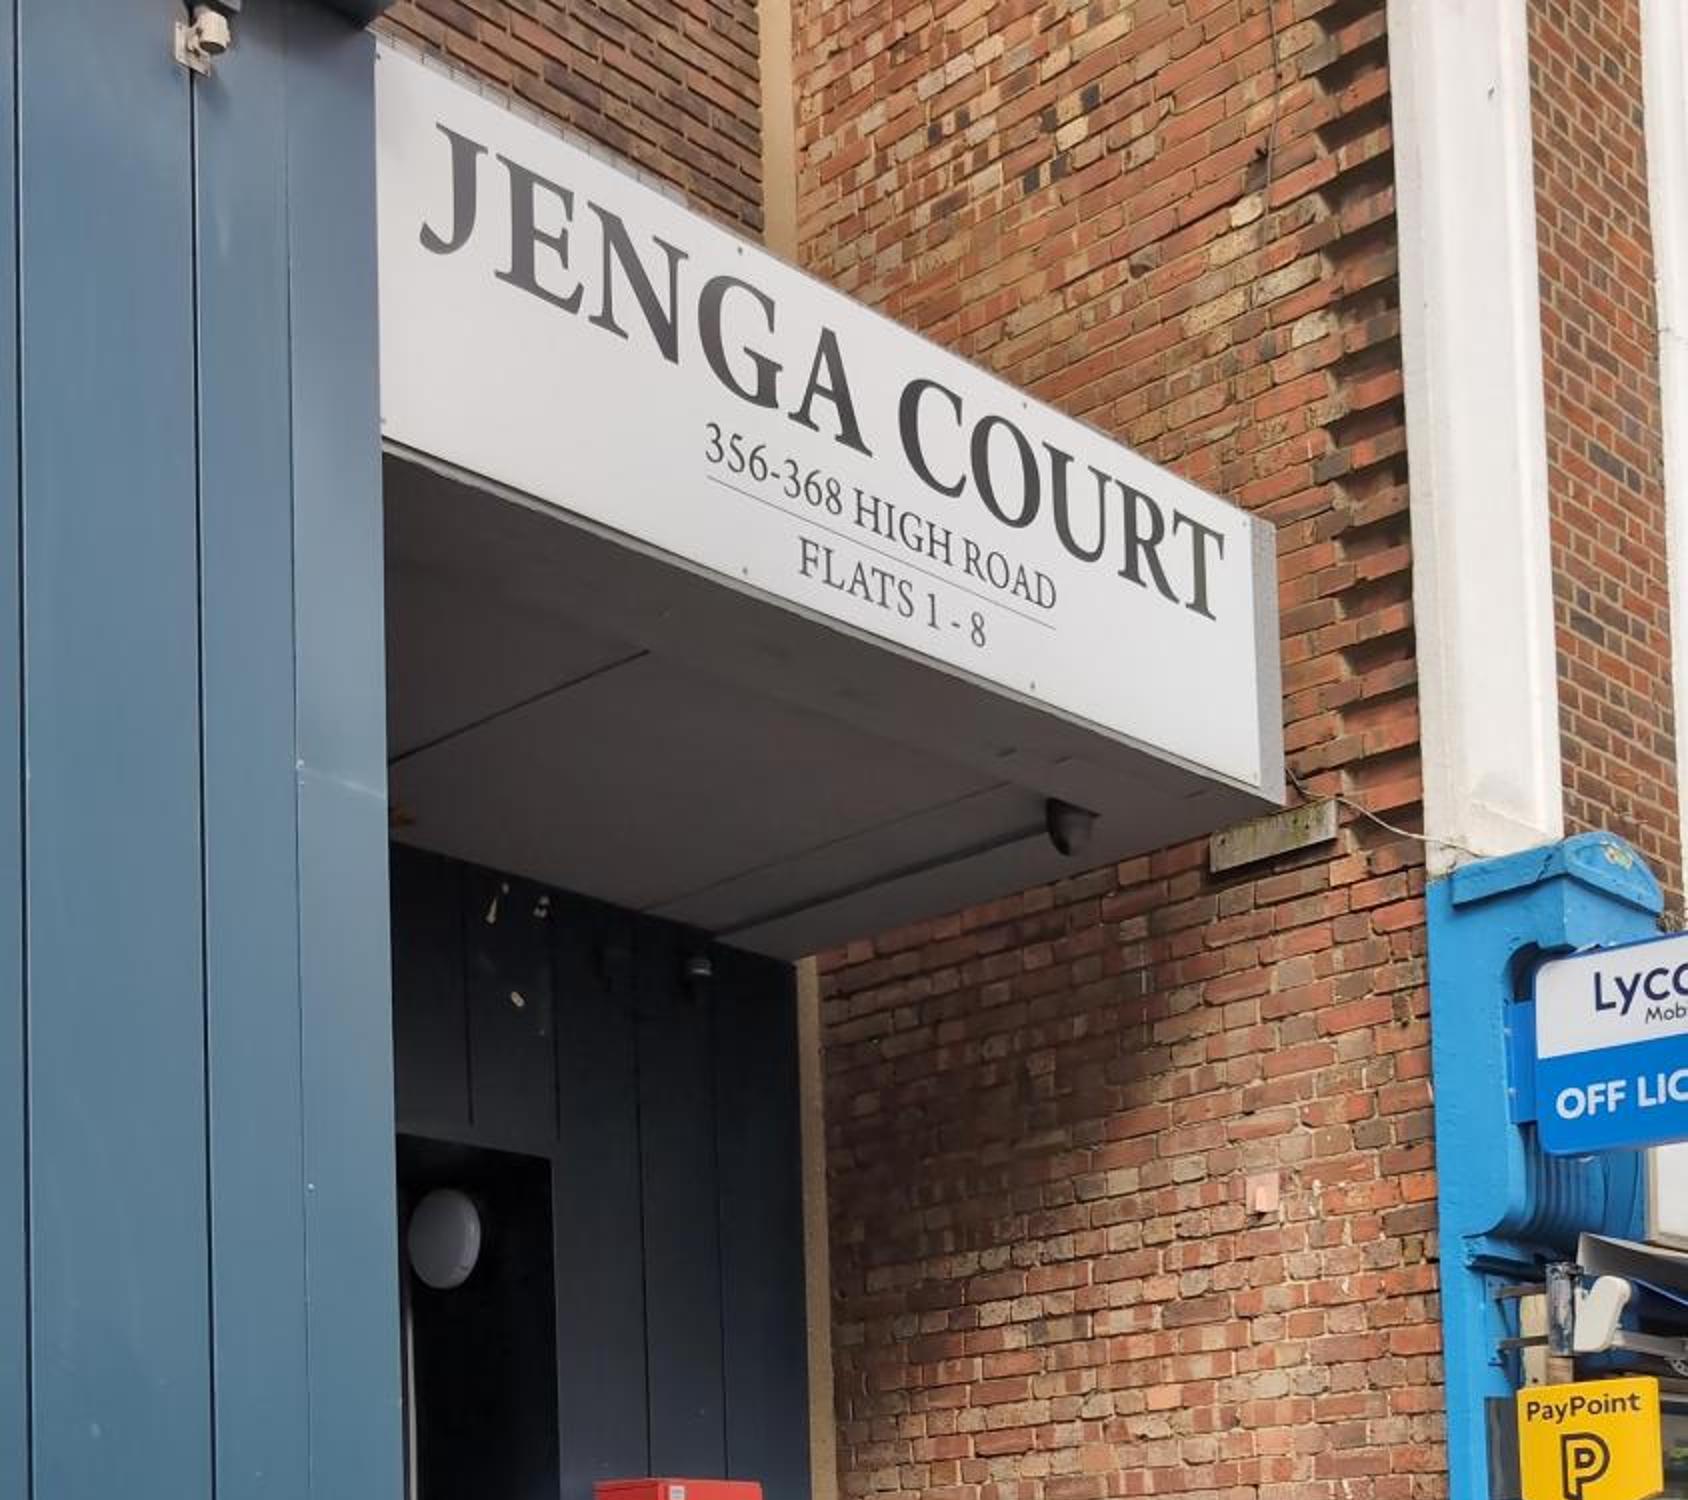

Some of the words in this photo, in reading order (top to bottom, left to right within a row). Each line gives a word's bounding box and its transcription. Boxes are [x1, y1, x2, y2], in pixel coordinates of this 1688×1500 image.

[420, 121, 874, 458] JENGA
[898, 378, 1225, 621] COURT
[705, 422, 843, 515] 356-368
[853, 488, 953, 566] HIGH
[963, 537, 1057, 610] ROAD
[799, 537, 915, 619] FLATS
[927, 593, 939, 630] 1
[970, 612, 986, 648] 8
[1556, 1079, 1627, 1120] OFF
[1527, 1391, 1641, 1424] PayPoint
